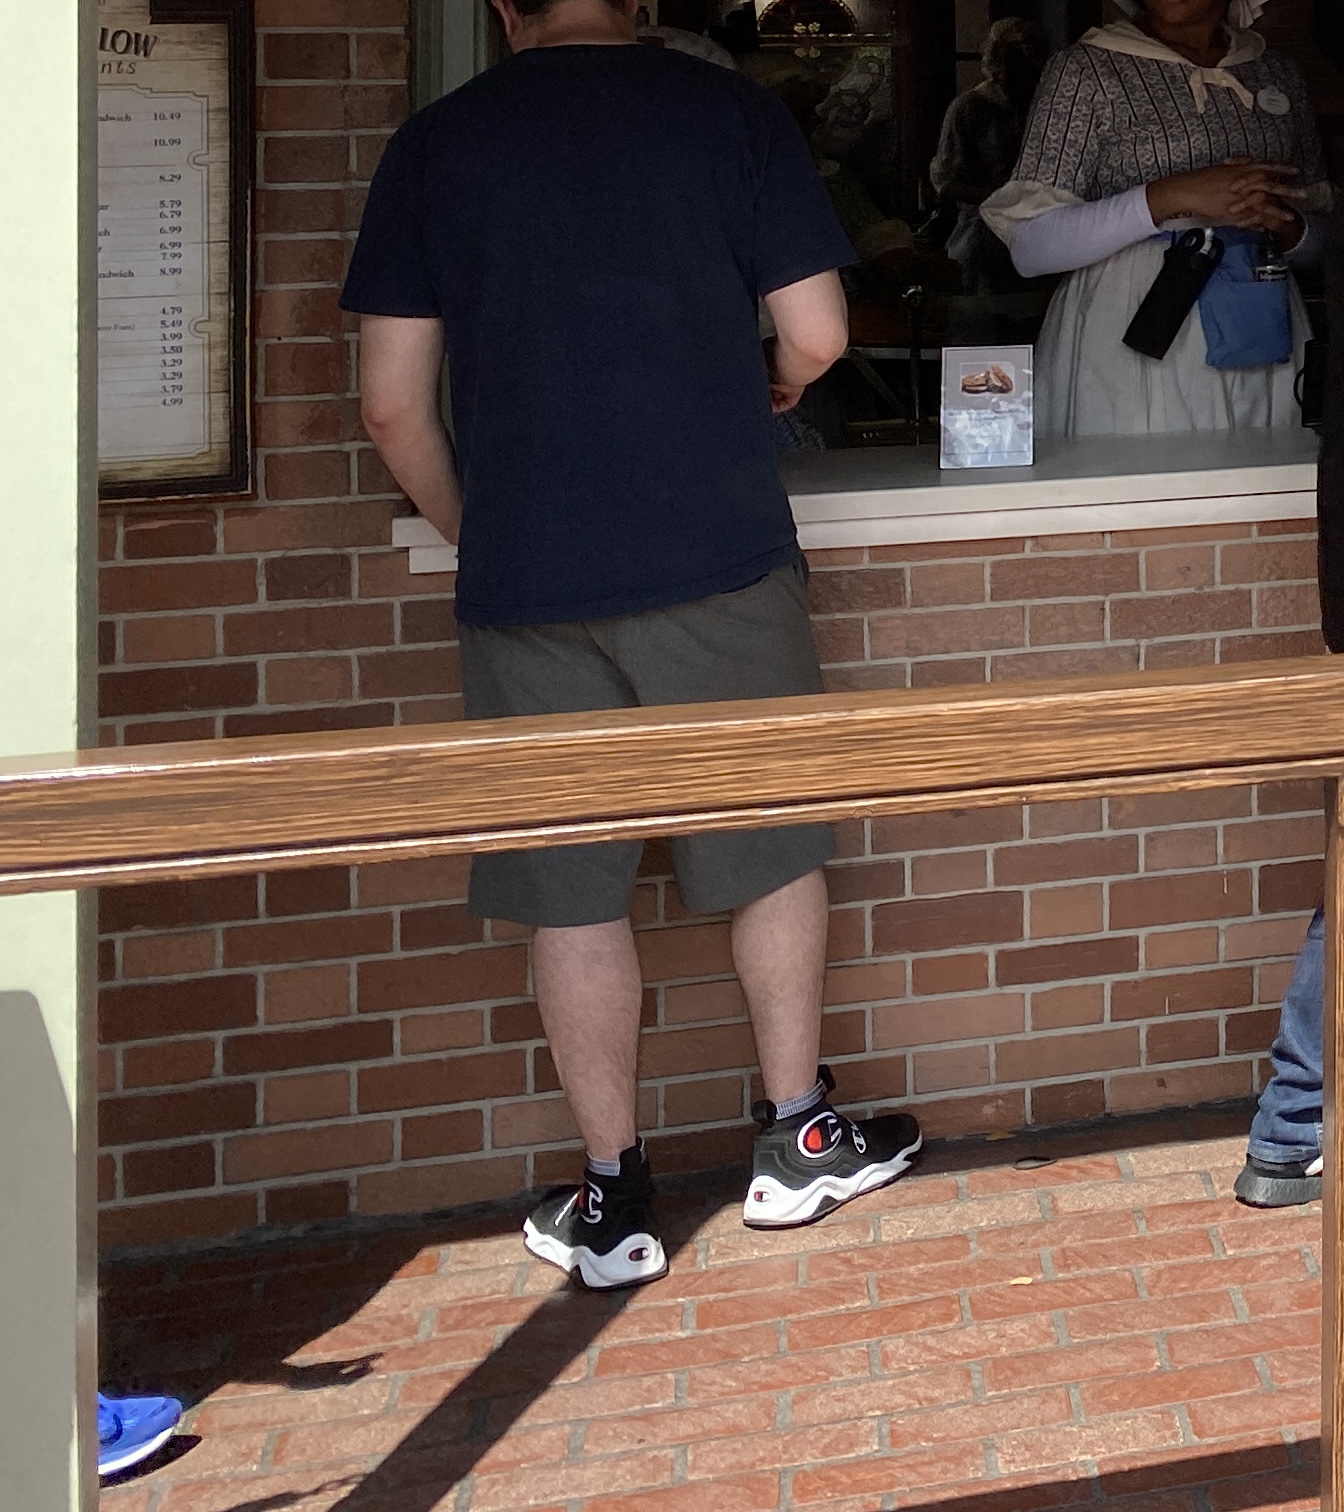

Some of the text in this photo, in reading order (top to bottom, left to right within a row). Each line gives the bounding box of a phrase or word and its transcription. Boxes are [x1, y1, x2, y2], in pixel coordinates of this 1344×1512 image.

[153, 112, 182, 121] 10.49
[153, 138, 182, 147] 10.99
[159, 174, 182, 183] 8.29
[159, 200, 182, 209] 5.79
[159, 210, 182, 219] 6.79
[159, 226, 182, 235] 6.99
[159, 241, 182, 250] 6.99
[160, 252, 182, 261] 7.99
[159, 267, 182, 277] 8.99
[160, 306, 183, 316] 4.79
[160, 319, 183, 329] 5.49
[160, 332, 183, 342] 3.99
[160, 397, 184, 407] 4.99
